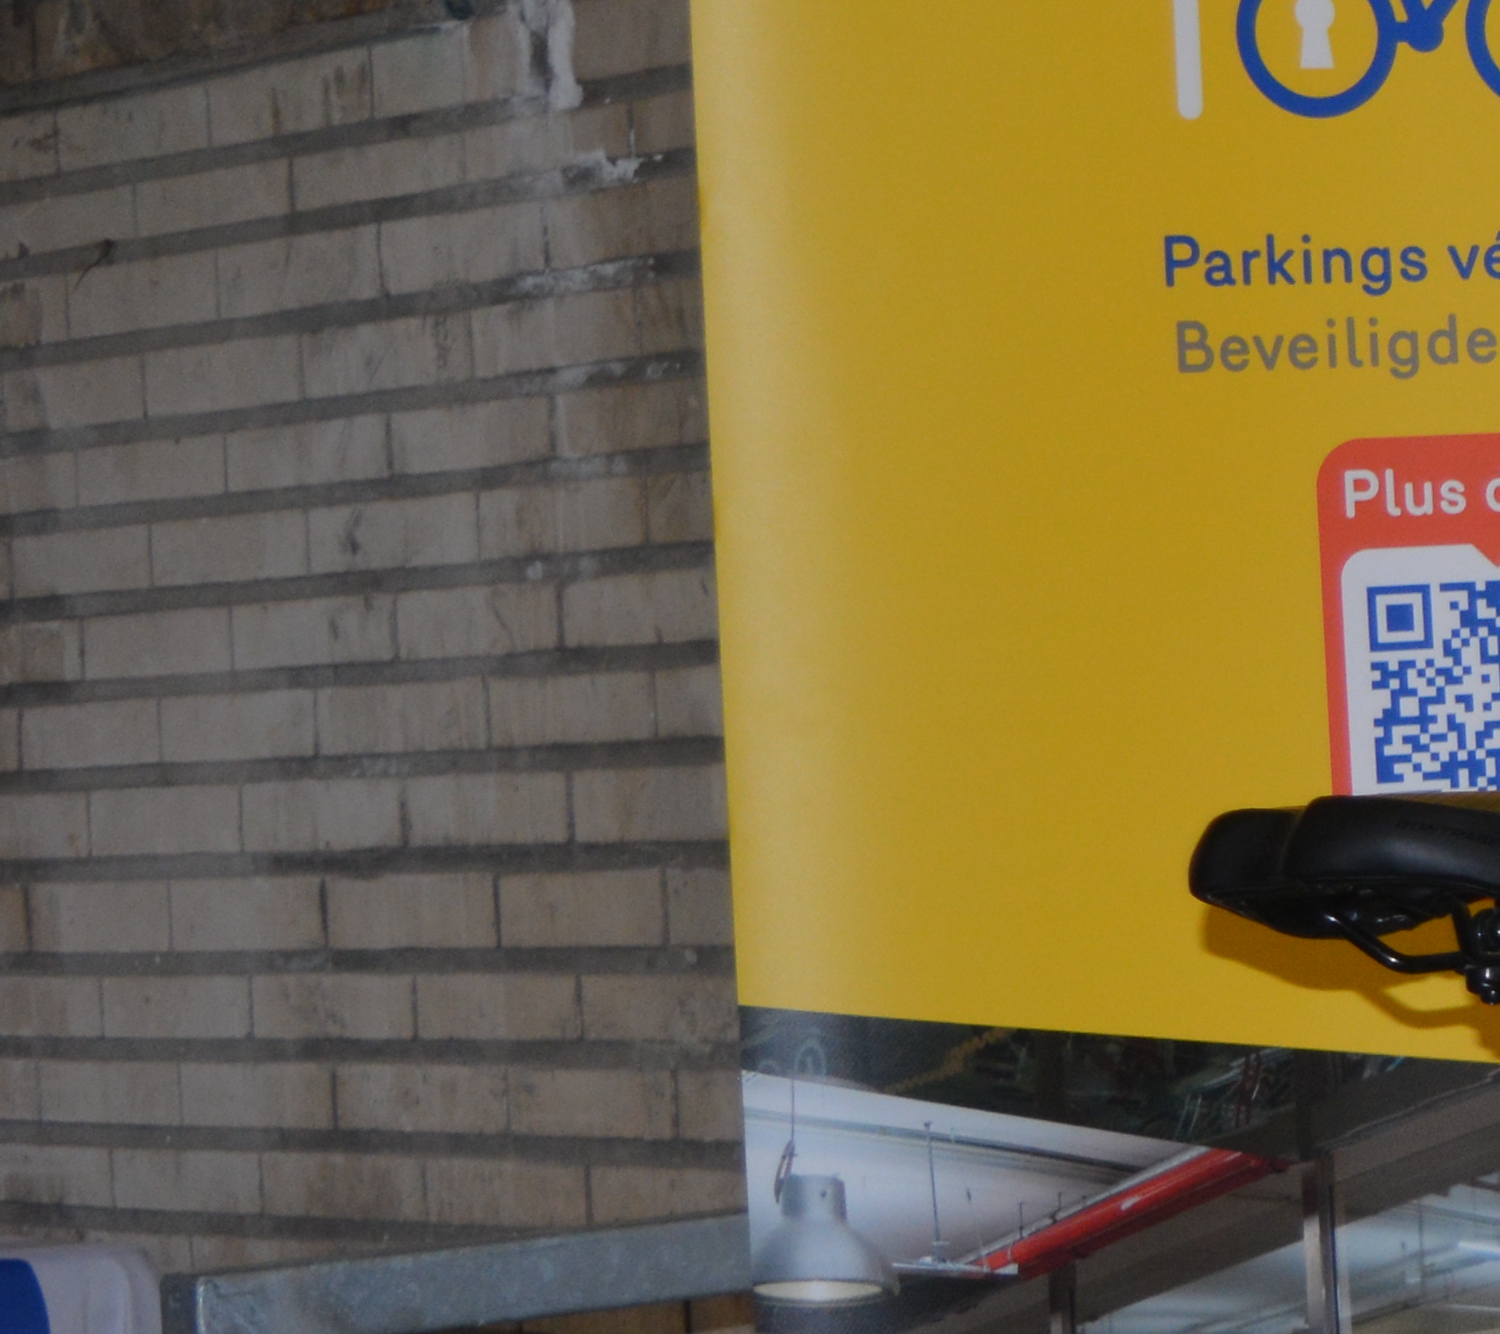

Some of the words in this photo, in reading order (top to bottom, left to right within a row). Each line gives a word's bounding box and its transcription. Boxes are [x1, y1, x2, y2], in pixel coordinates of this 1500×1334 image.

[1164, 234, 1428, 296] Parkings
[1176, 314, 1498, 380] Beveiligde
[1344, 469, 1466, 518] Plus
